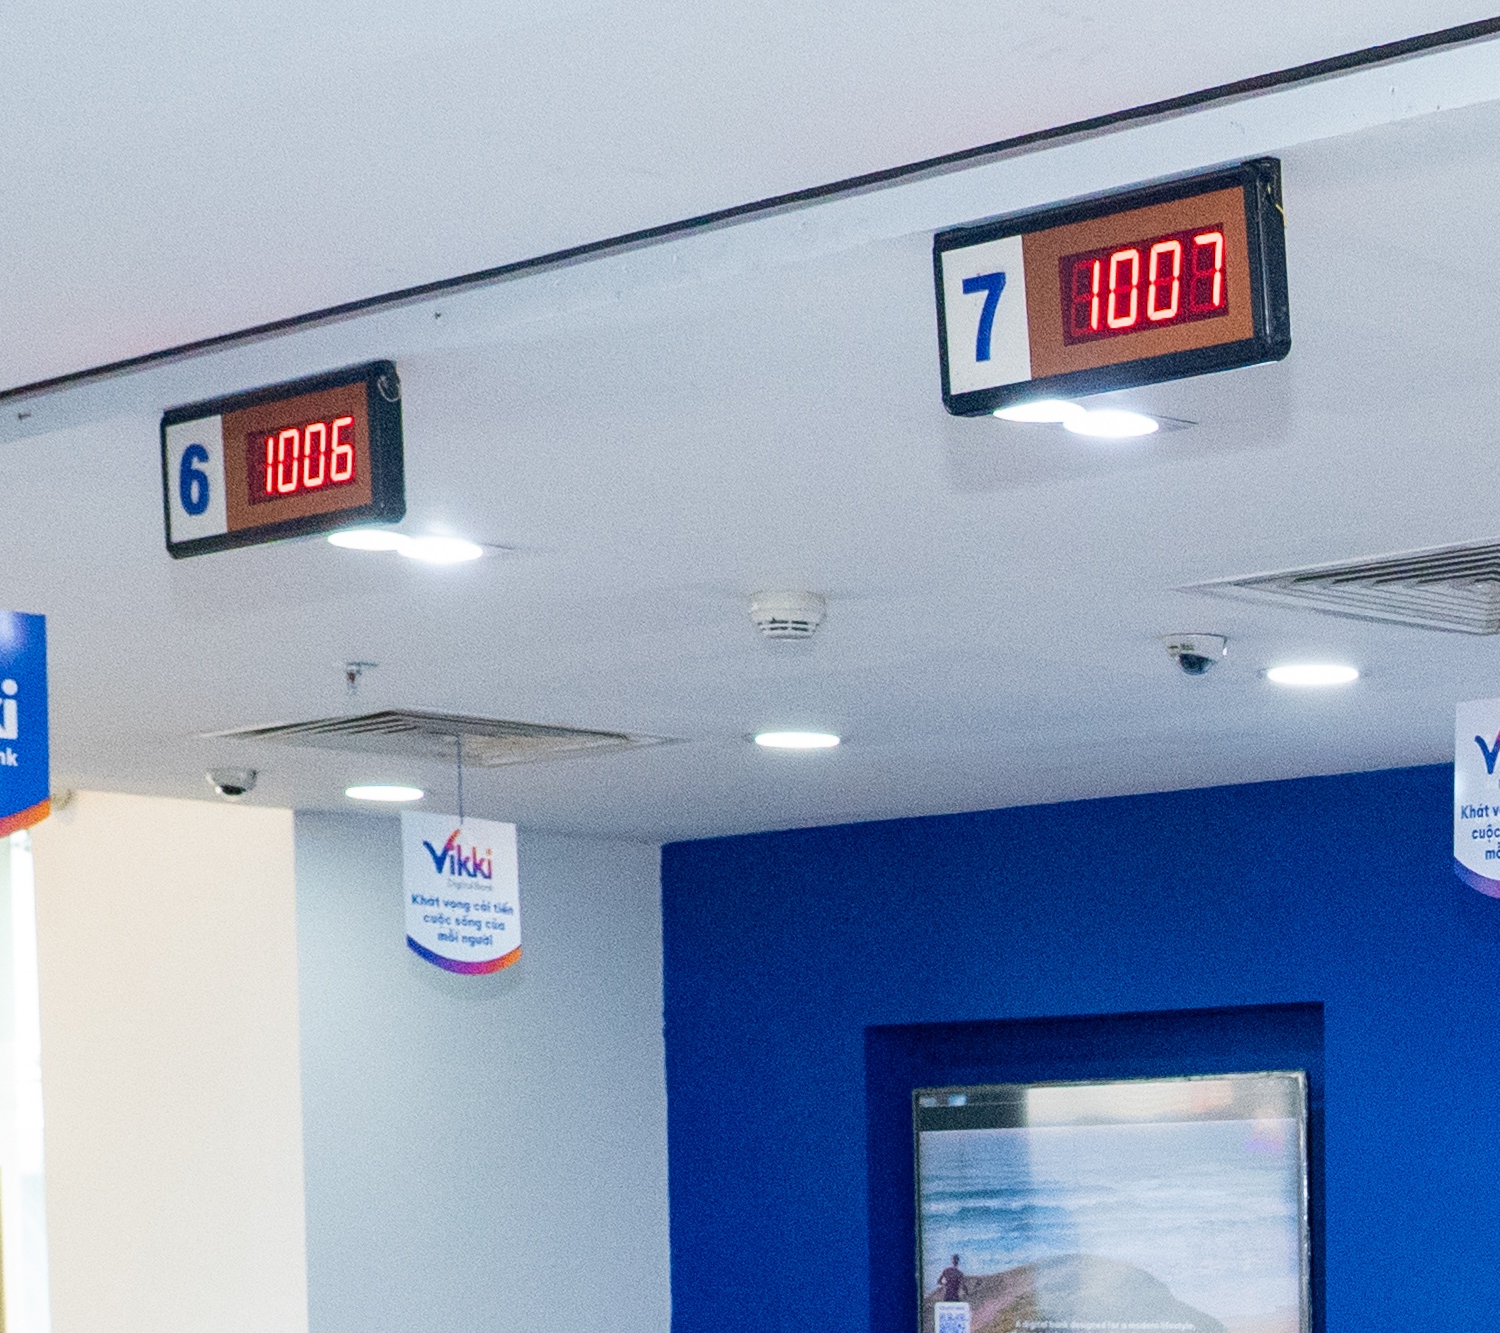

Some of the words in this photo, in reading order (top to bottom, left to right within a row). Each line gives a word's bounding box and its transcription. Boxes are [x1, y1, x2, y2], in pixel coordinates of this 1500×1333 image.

[961, 271, 1007, 363] 7
[1089, 230, 1225, 331] 1007
[178, 442, 211, 516] 6
[264, 415, 355, 495] 1006
[1461, 803, 1490, 819] Khát
[1472, 824, 1500, 843] cuộc
[422, 828, 492, 879] Vikki
